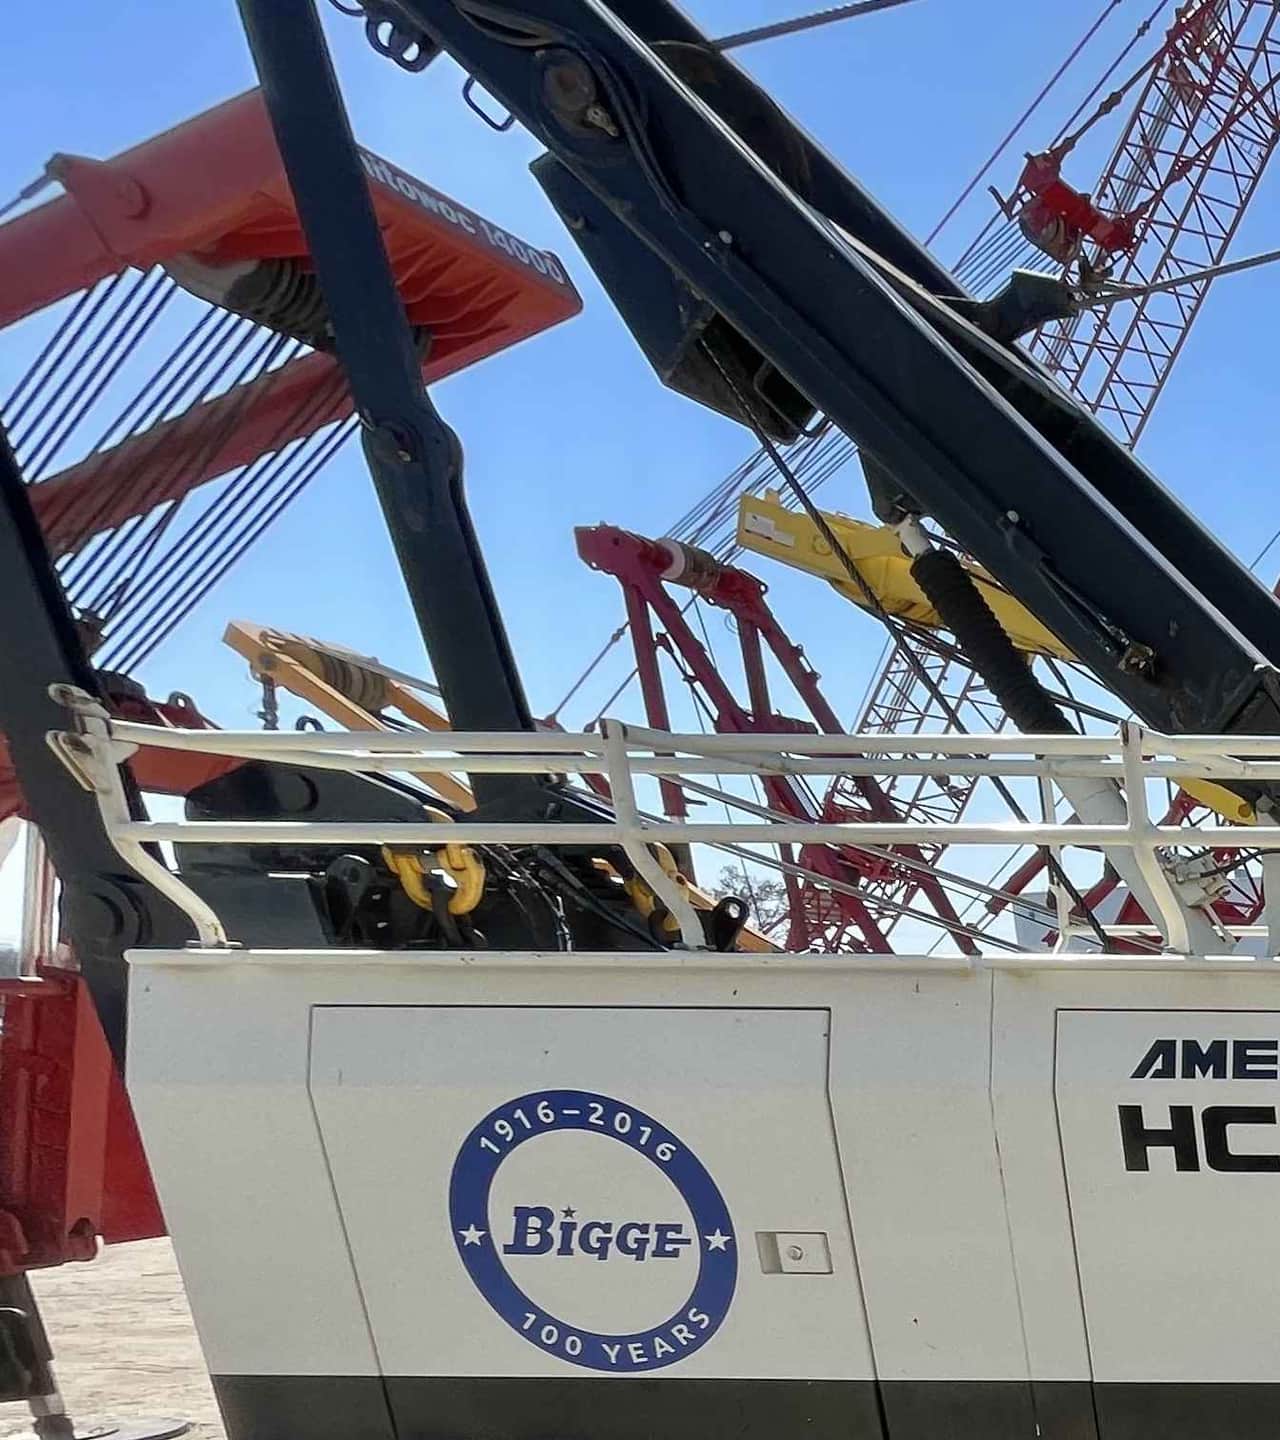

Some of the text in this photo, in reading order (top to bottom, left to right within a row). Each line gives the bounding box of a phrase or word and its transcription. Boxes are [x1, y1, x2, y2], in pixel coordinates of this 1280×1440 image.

[480, 1101, 677, 1164] 1916-2016
[503, 1205, 692, 1261] BIGGE
[521, 1307, 711, 1365] 100 YEARS
